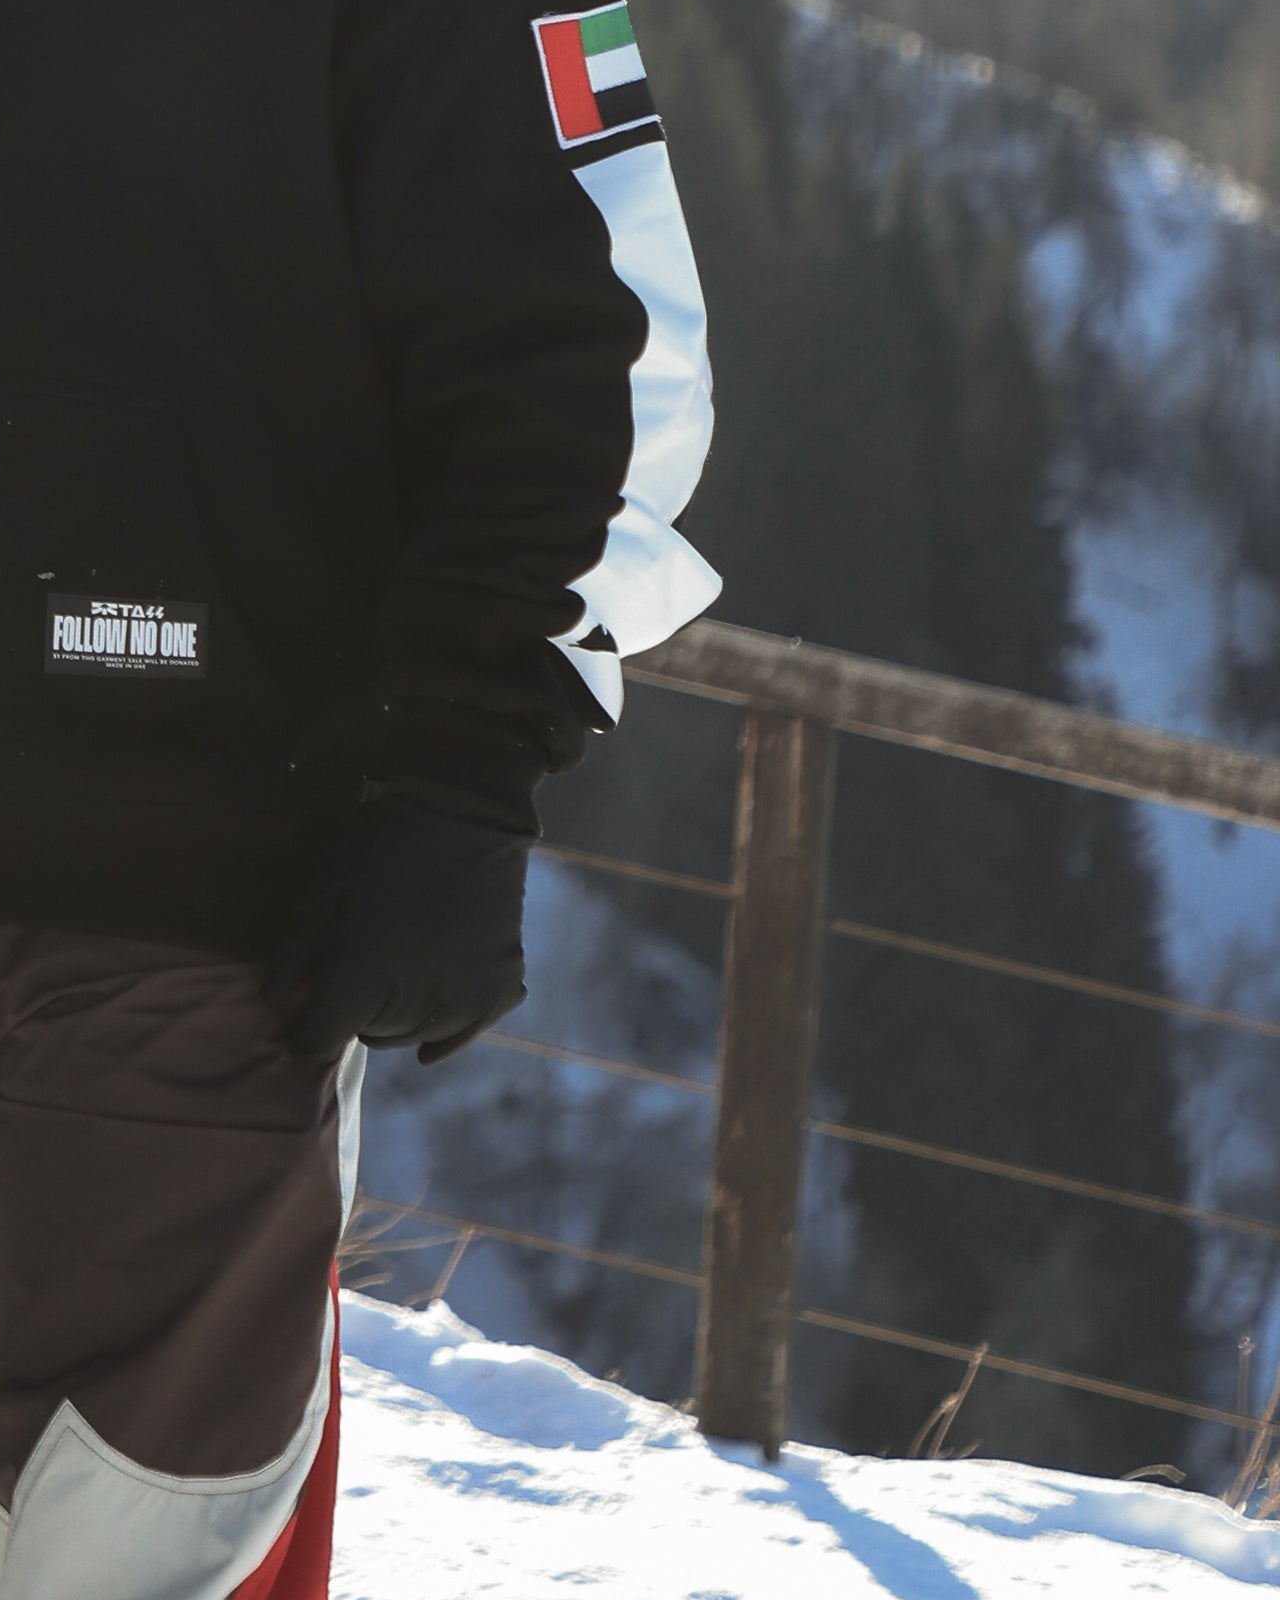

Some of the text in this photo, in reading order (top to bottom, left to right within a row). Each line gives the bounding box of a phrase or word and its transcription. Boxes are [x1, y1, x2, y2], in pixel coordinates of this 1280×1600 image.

[53, 615, 198, 658] FOLLOW NO ONE
